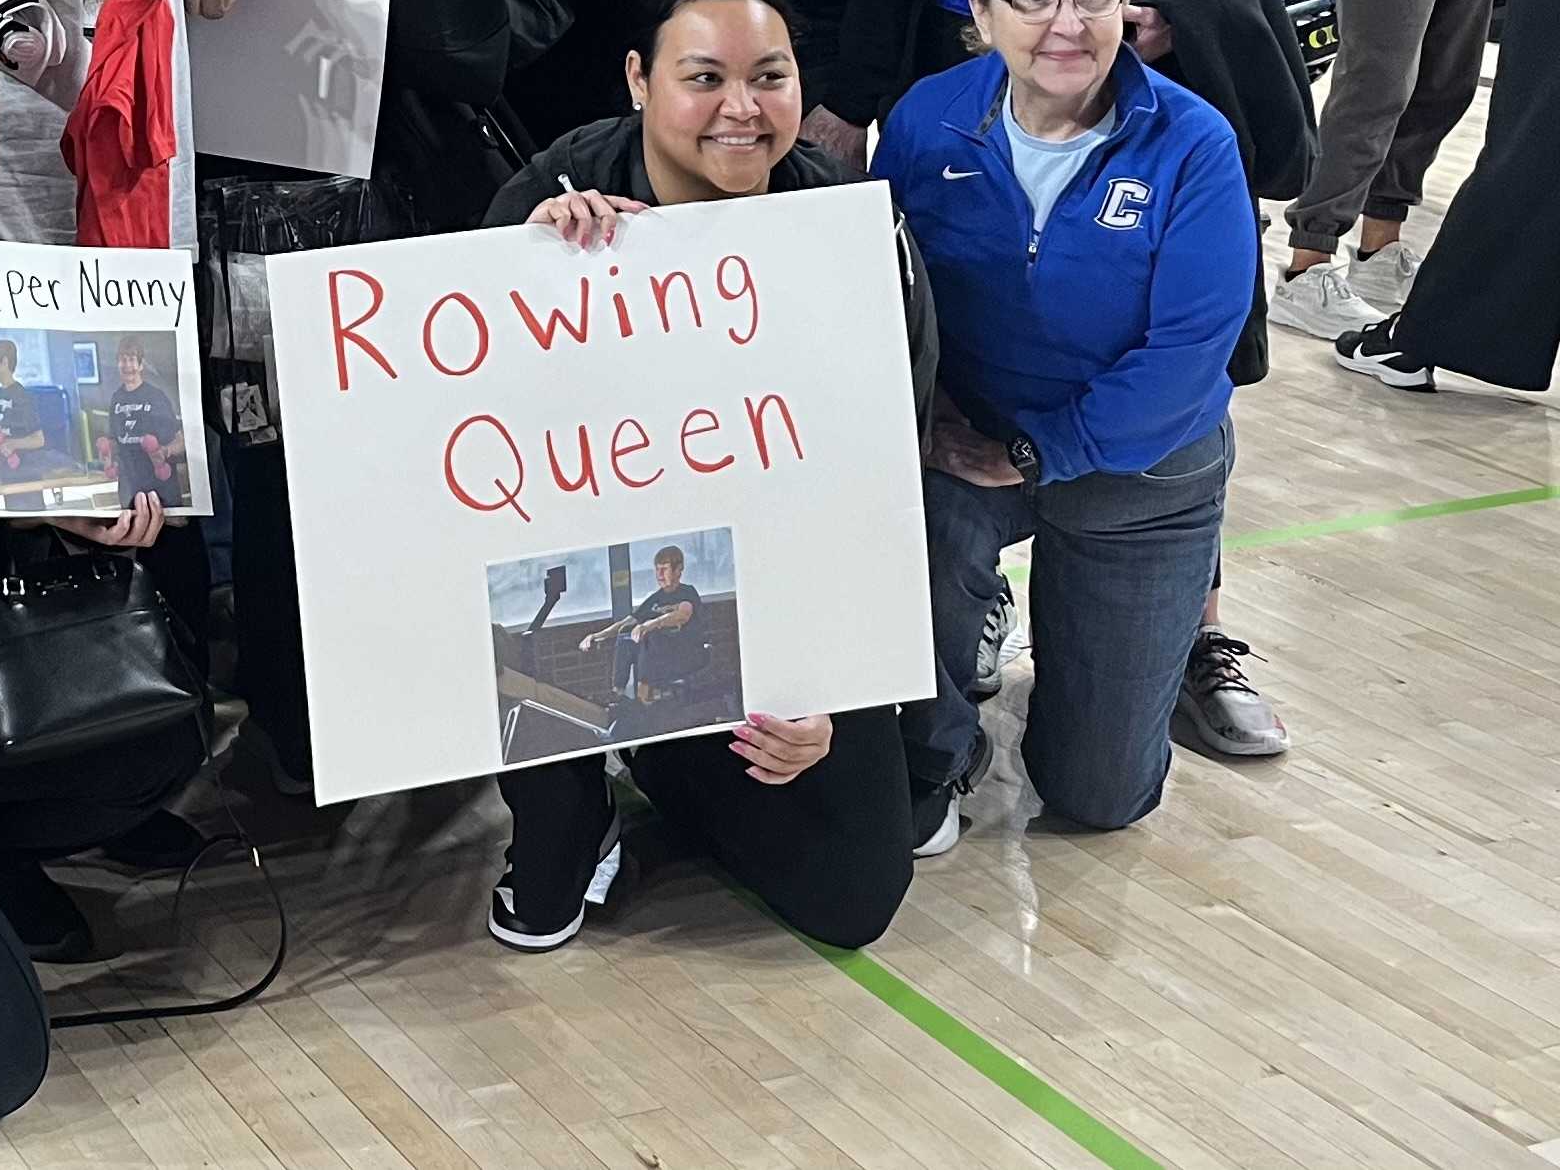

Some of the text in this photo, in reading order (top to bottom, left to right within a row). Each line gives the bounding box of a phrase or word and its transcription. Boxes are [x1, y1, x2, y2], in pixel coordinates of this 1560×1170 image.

[1094, 177, 1153, 231] C
[79, 258, 186, 328] Nanny
[328, 254, 761, 391] Rowing
[443, 393, 805, 523] Queen
